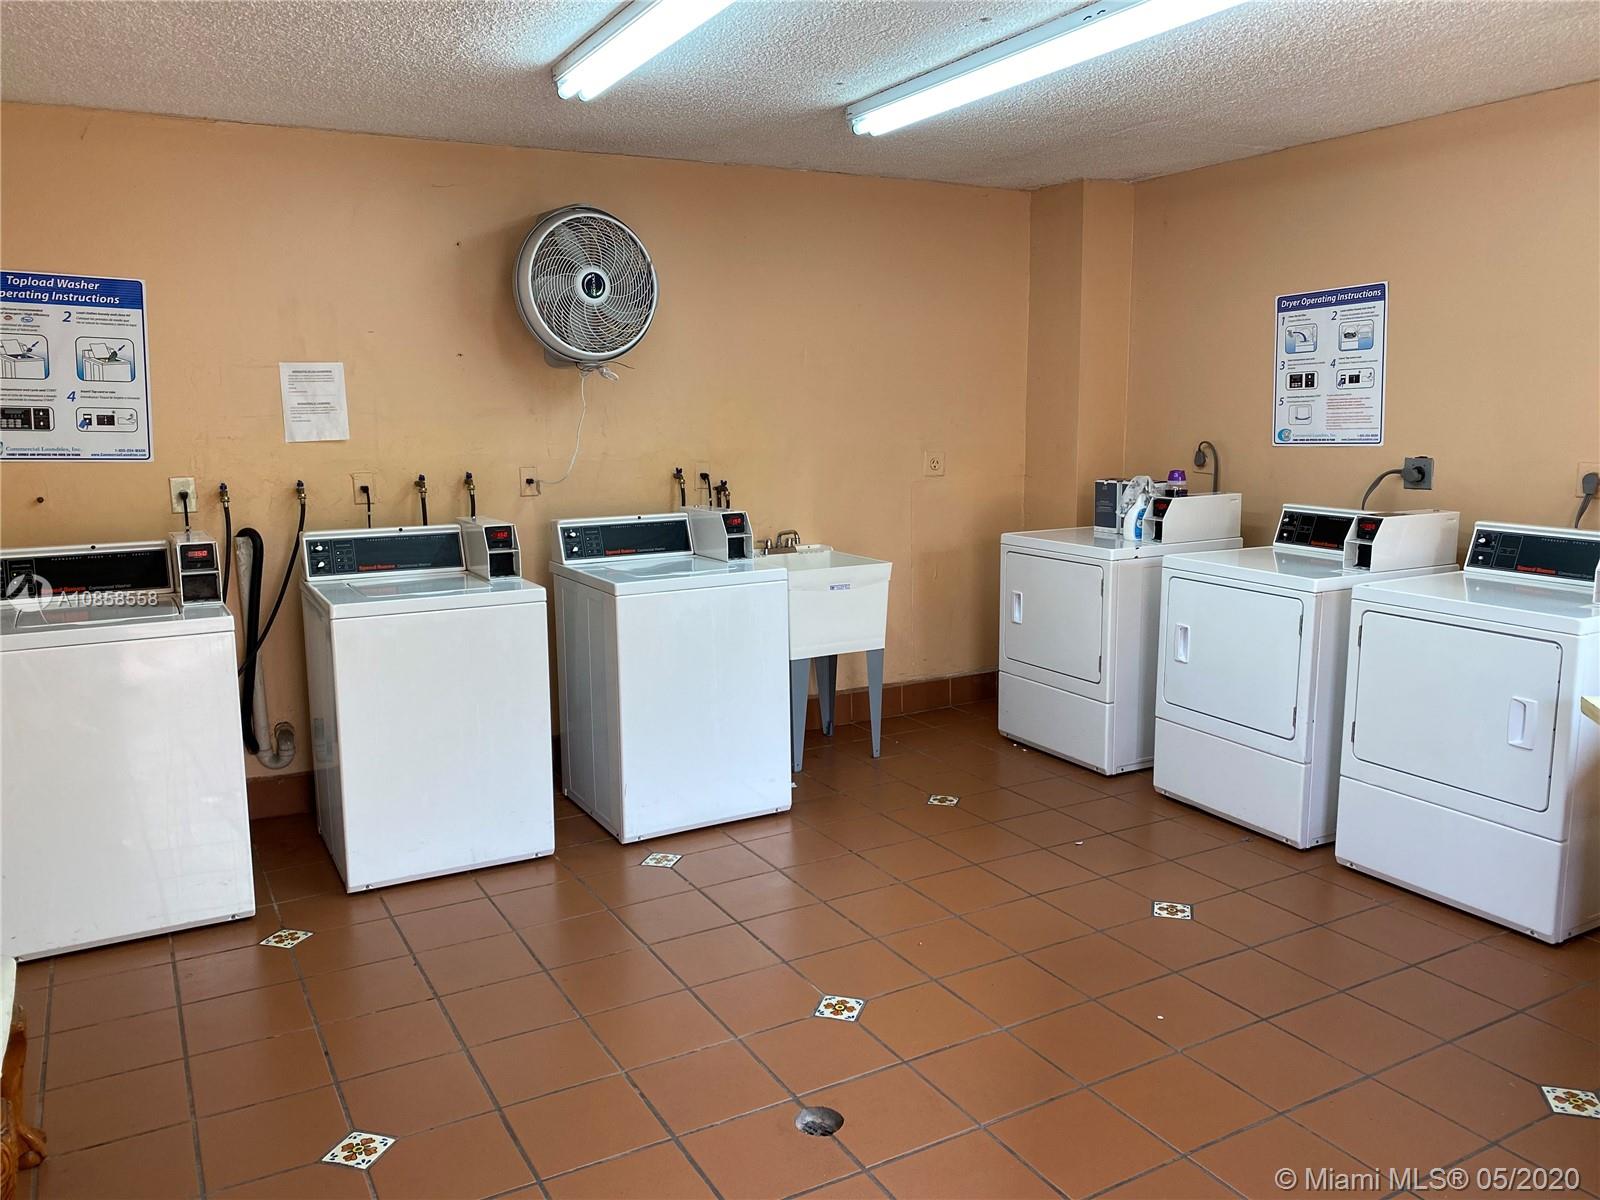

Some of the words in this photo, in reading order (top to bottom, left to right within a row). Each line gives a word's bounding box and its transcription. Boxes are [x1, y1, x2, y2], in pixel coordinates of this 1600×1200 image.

[6, 275, 54, 288] Topload
[57, 279, 100, 290] Washer
[0, 289, 49, 302] perating
[52, 291, 120, 304] Instructions
[1281, 299, 1300, 308] Dryer
[1301, 294, 1336, 306] Operating
[1337, 289, 1381, 301] Instructions
[62, 311, 72, 322] 2
[1331, 311, 1338, 320] 2
[1281, 316, 1285, 326] 1
[1280, 361, 1285, 370] 3
[1330, 359, 1336, 369] 4
[67, 391, 76, 402] 4
[1279, 397, 1285, 406] 5
